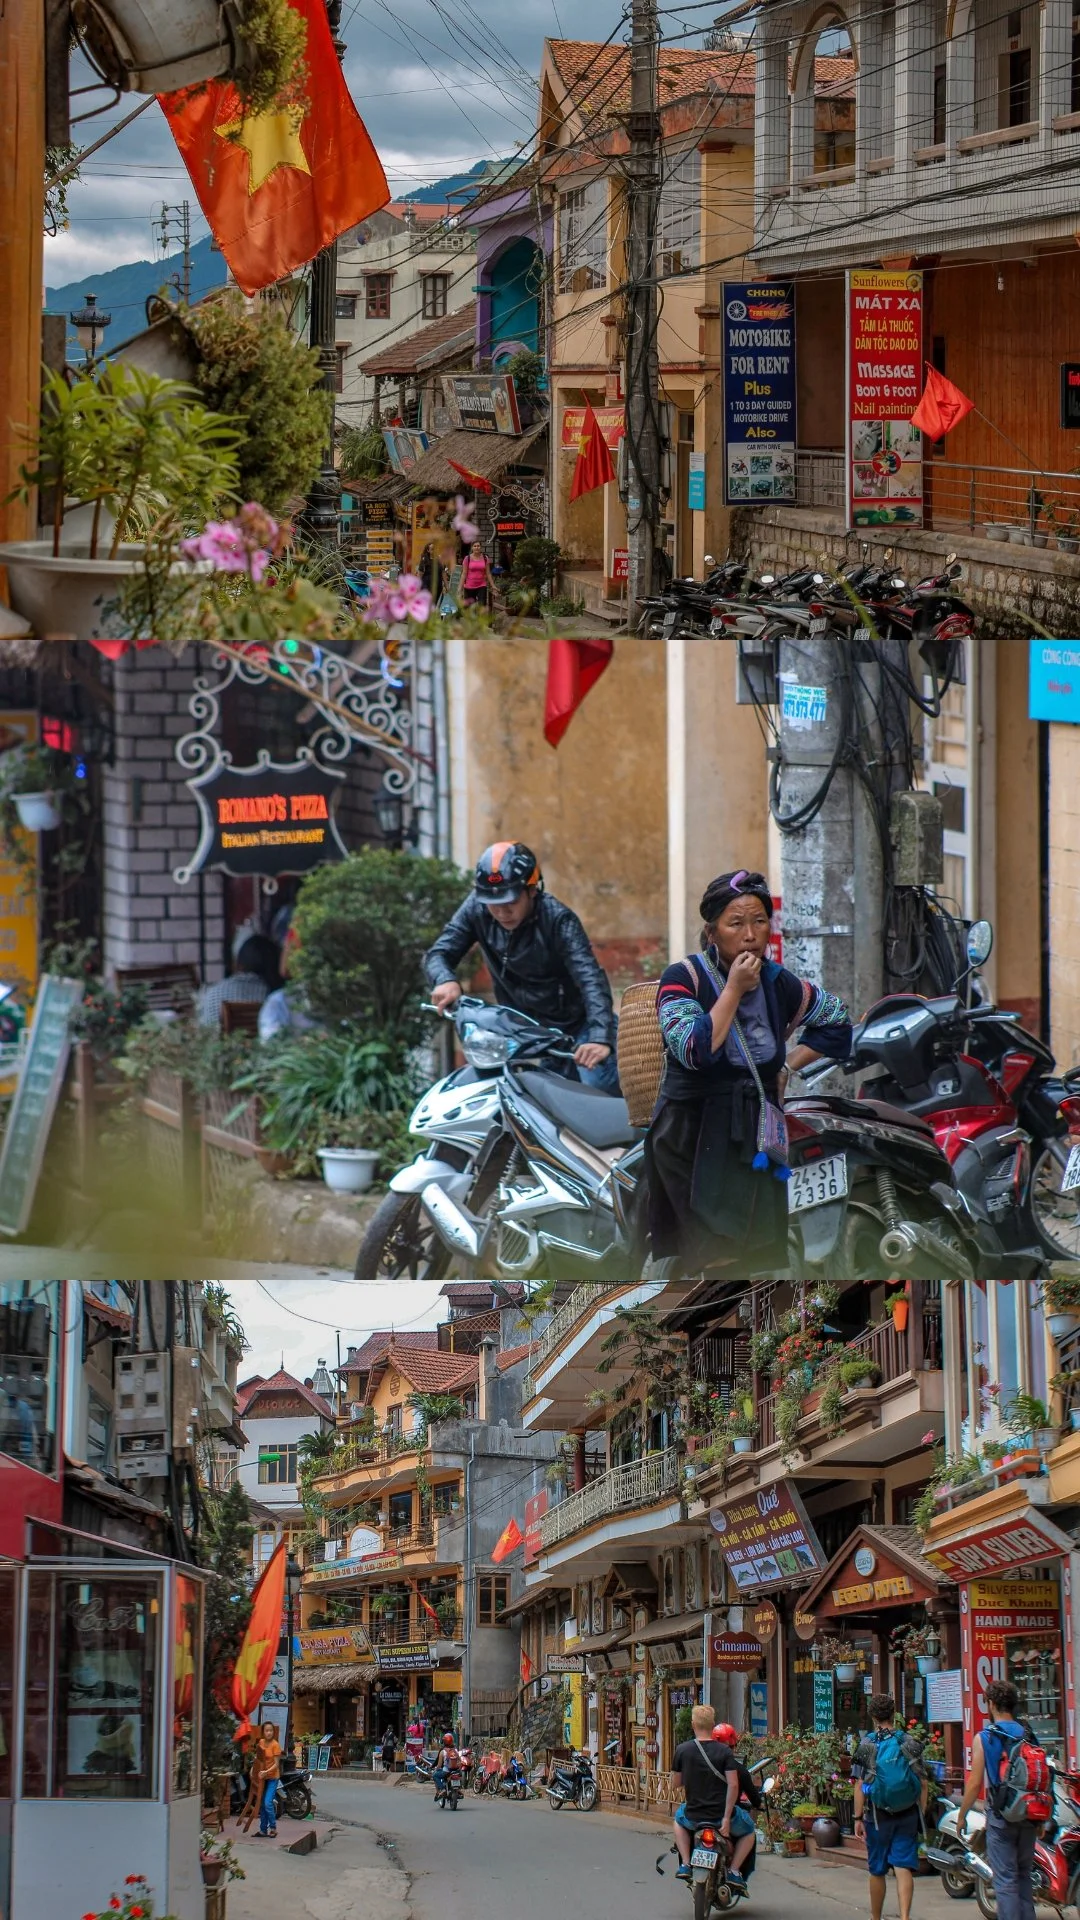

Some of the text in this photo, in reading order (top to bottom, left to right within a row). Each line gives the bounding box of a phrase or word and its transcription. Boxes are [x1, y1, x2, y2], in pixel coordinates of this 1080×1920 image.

[853, 274, 904, 288] Sunflowers
[746, 289, 785, 297] CHUNG
[855, 293, 921, 311] MÁT XA
[729, 329, 791, 347] MOTOBIKE
[730, 357, 790, 374] FOR RENT
[744, 381, 772, 396] Plus
[855, 384, 881, 397] BODY
[892, 386, 917, 398] FOOT
[735, 402, 745, 411] TO
[745, 402, 750, 410] 3
[751, 402, 766, 411] DAY
[766, 401, 792, 410] GUIDED
[854, 401, 875, 415] Nail
[733, 413, 788, 423] MOTOBIKE DRIVE
[745, 427, 776, 438] Also
[217, 793, 329, 823] ROMANO'S PIZZA
[794, 1178, 838, 1208] 2336
[756, 1483, 780, 1517] Quế
[945, 1527, 1054, 1573] SAPA SILVER
[832, 1576, 914, 1606] LEGEND HOTEL
[977, 1598, 1053, 1608] Duc Khanh
[975, 1615, 1055, 1627] HAND MADE
[975, 1632, 1005, 1641] HIGH
[714, 1639, 762, 1653] Cinnamon
